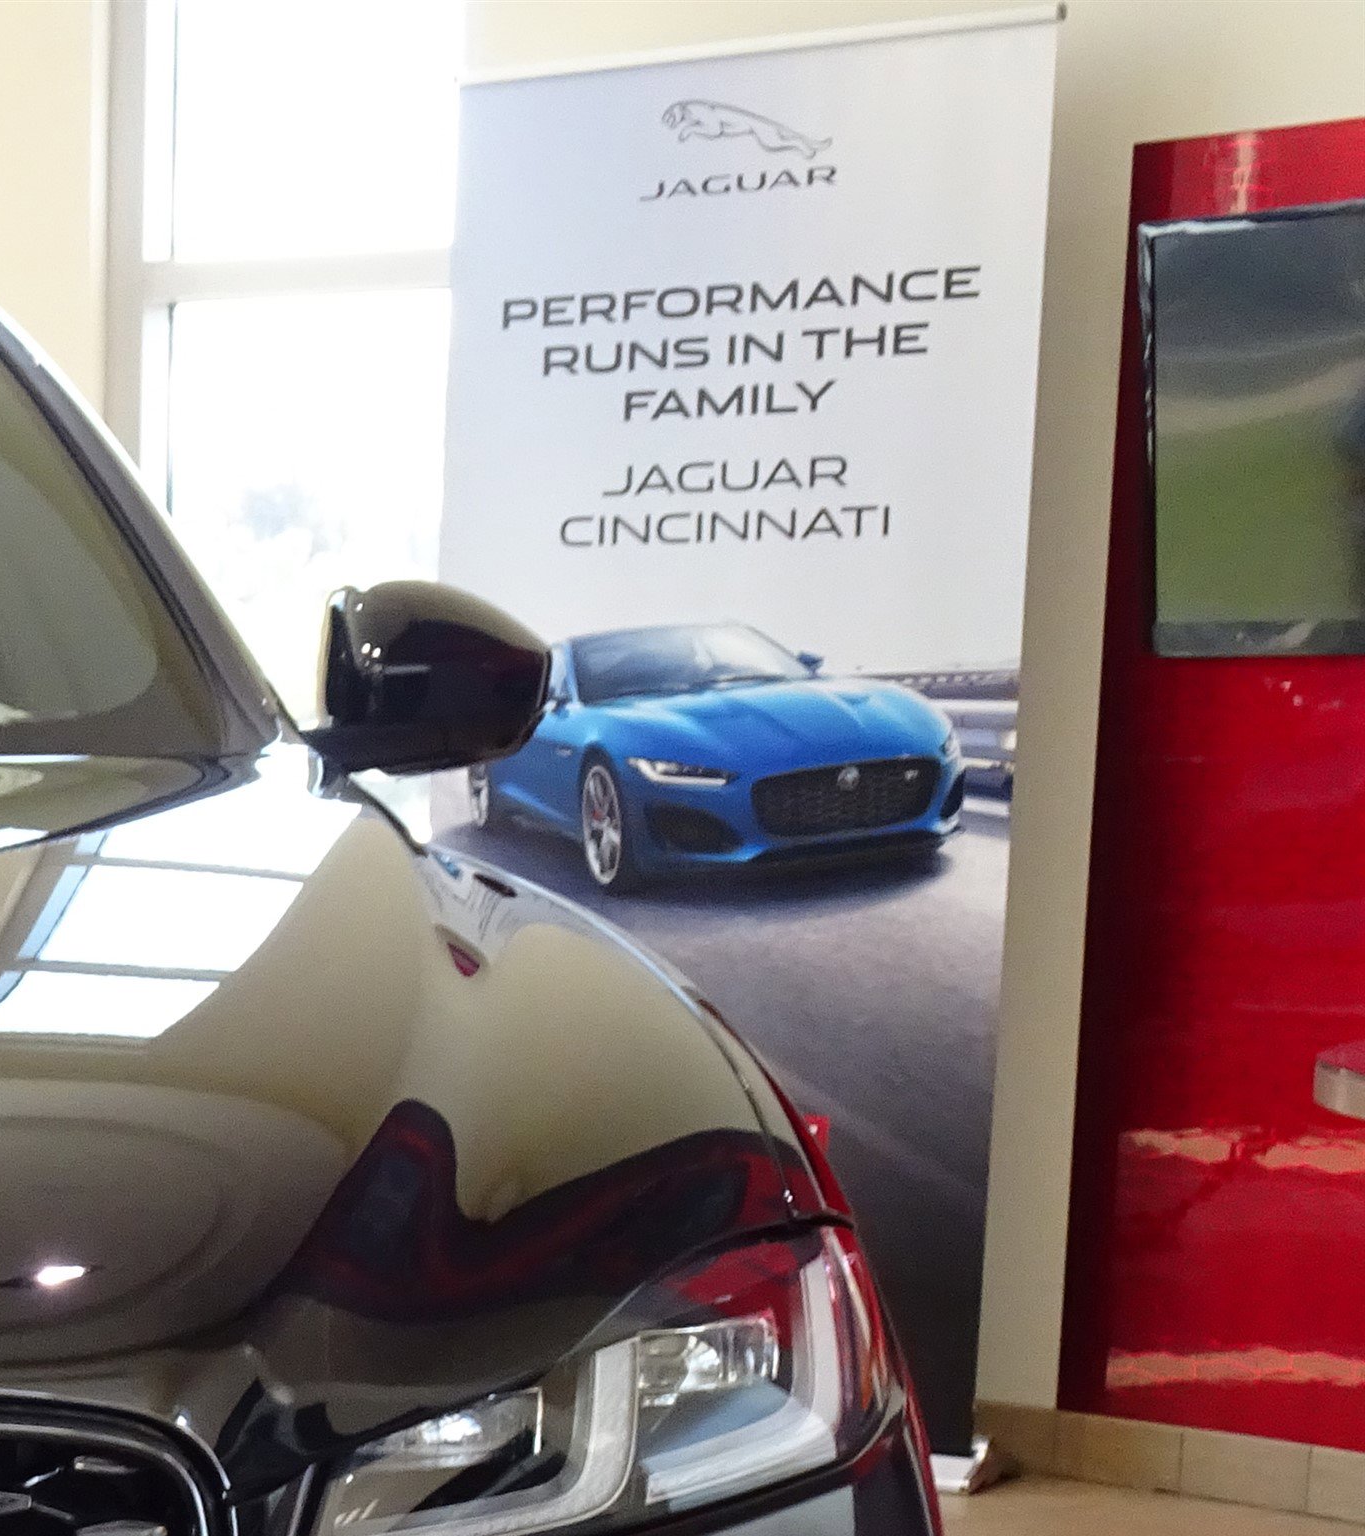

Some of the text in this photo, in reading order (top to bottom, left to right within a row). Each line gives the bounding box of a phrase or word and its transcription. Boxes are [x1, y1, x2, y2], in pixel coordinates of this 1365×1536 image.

[640, 165, 837, 201] JAGUAR
[502, 265, 981, 330] PERFORMANCE
[543, 322, 929, 377] RUNS IN THE
[623, 380, 836, 422] FAMILY
[603, 455, 848, 497] JAGUAR
[560, 505, 891, 548] CINCINNATI
